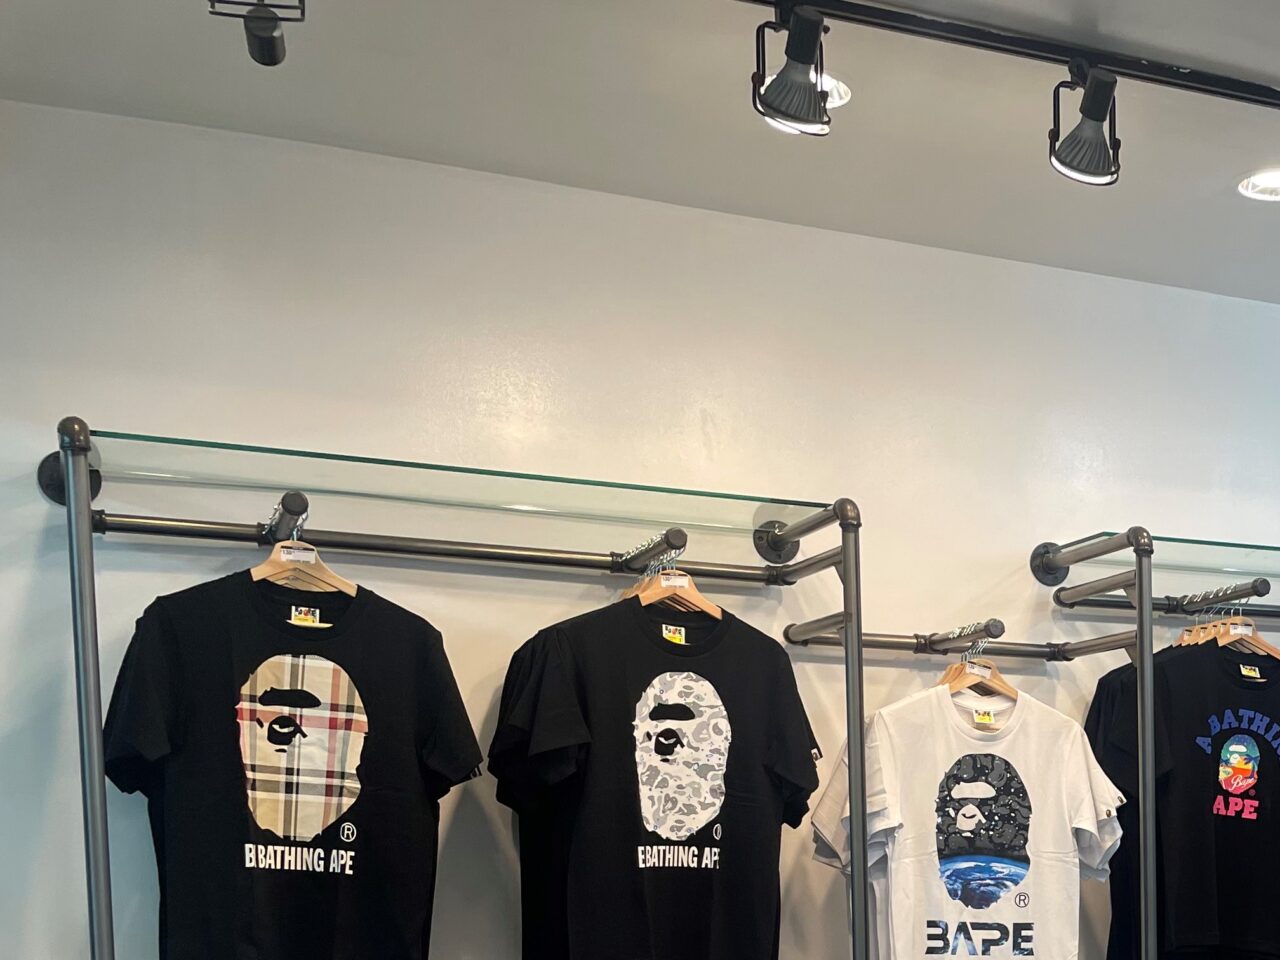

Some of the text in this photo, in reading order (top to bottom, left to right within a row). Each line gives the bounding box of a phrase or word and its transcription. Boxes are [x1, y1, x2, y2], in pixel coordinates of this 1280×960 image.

[1212, 795, 1259, 820] APE
[329, 849, 356, 875] APE
[924, 919, 1035, 956] BAPE
